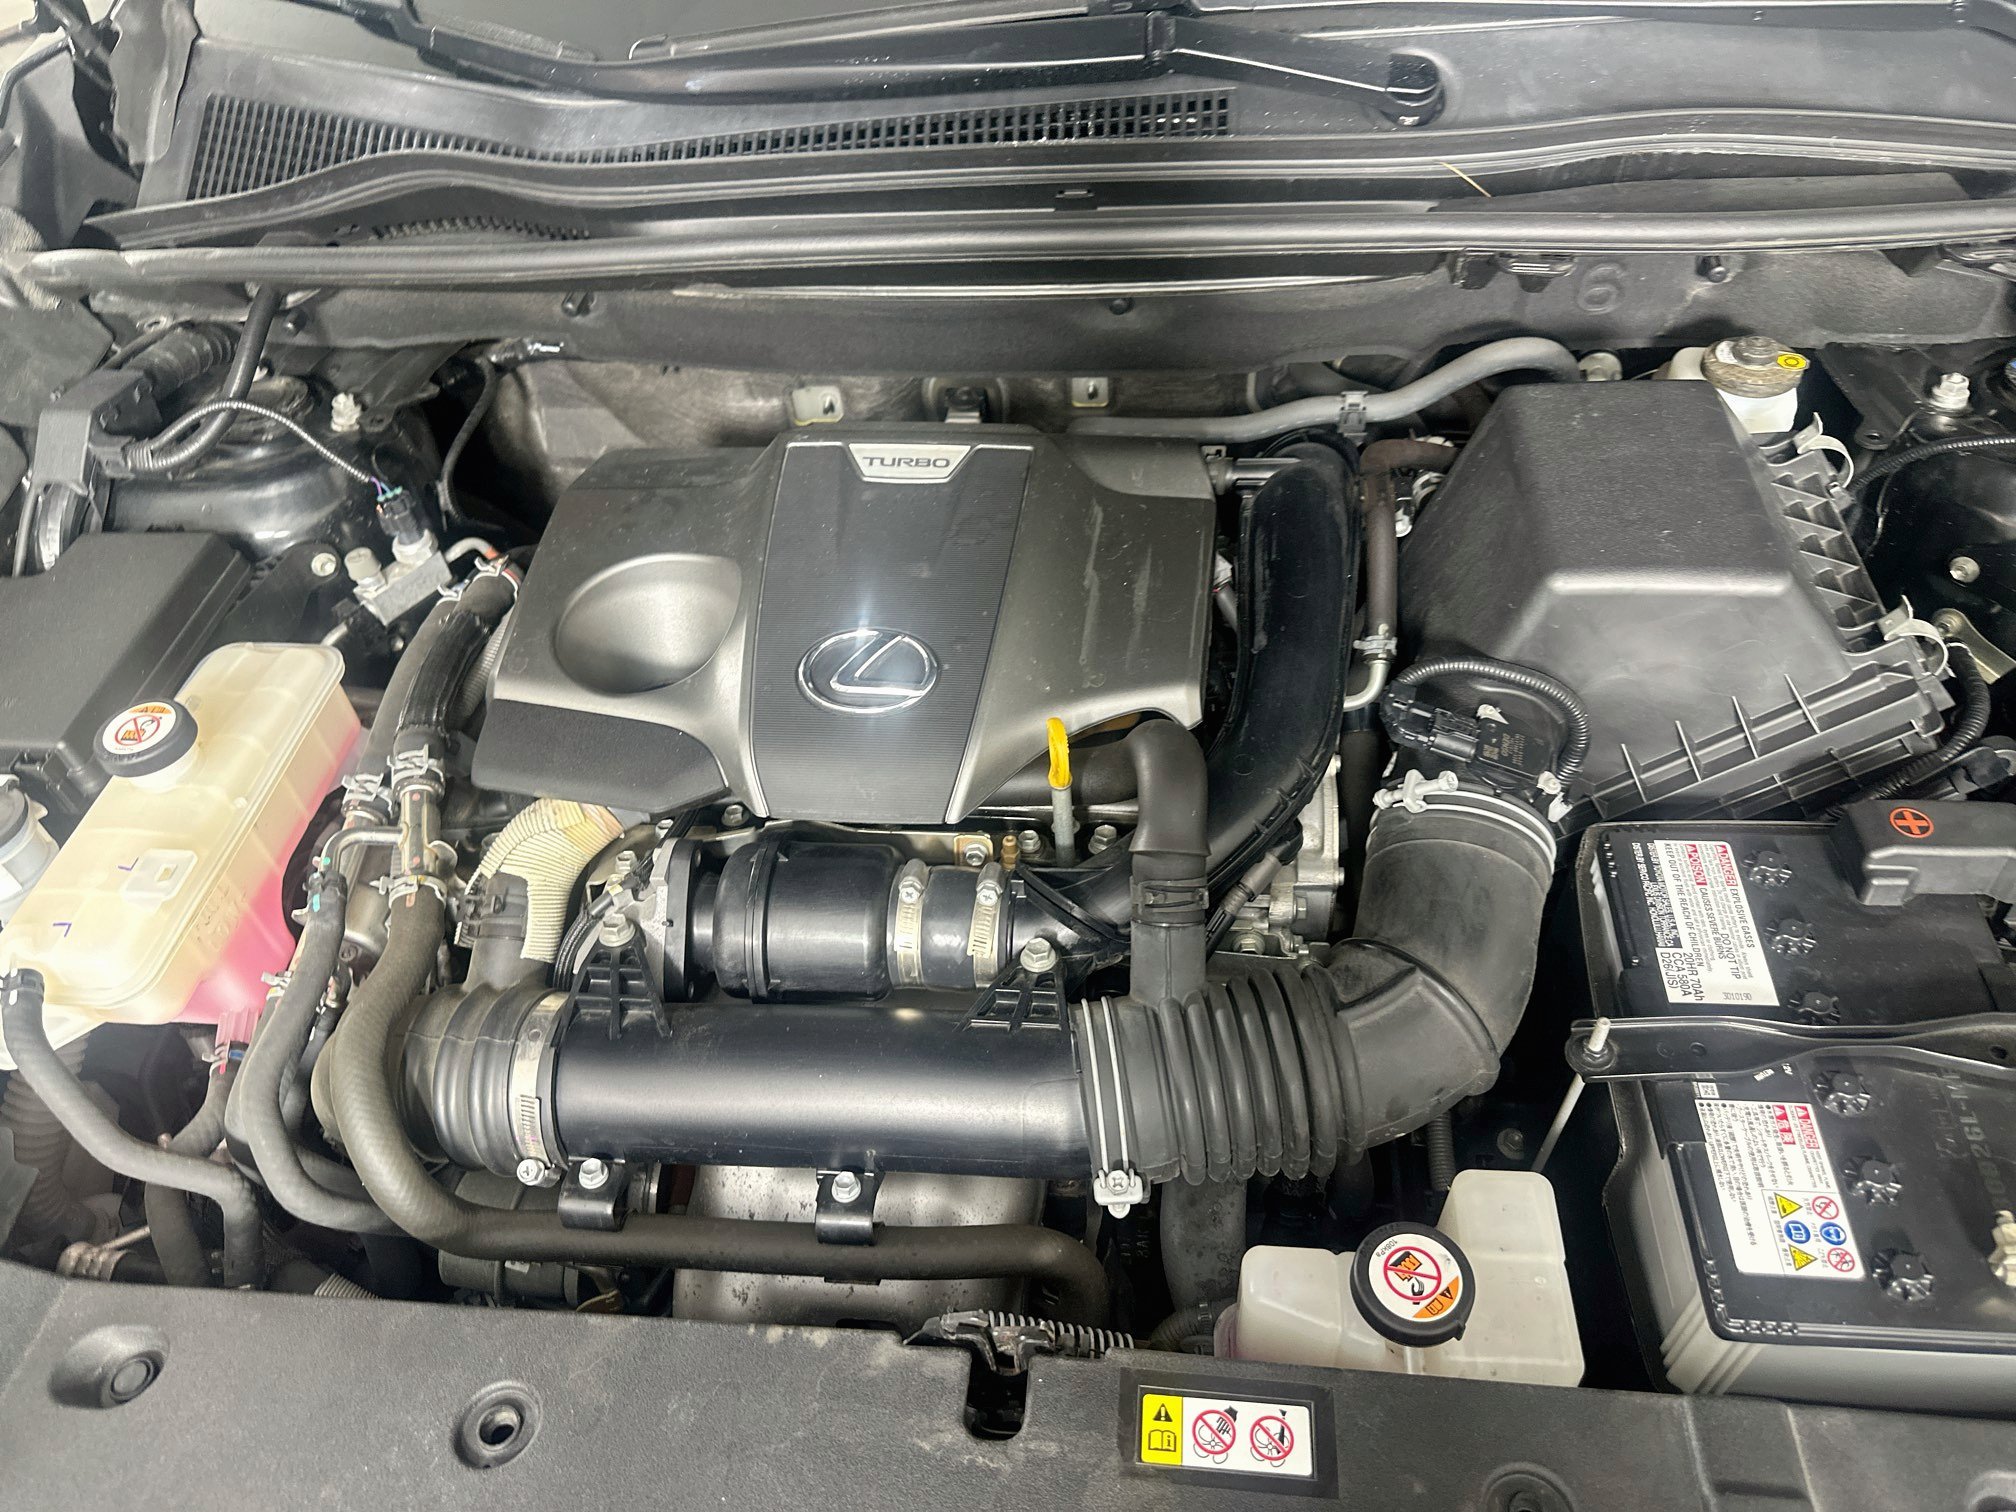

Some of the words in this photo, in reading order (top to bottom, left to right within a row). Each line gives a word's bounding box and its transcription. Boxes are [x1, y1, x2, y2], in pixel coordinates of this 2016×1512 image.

[862, 456, 950, 469] TURBO
[1664, 844, 1675, 859] KEEP
[1669, 860, 1679, 872] OUT
[1675, 885, 1686, 896] THE
[1679, 898, 1692, 920] REACH
[1688, 853, 1706, 882] POISON
[1699, 888, 1713, 911] CAUSES
[1706, 913, 1720, 935] SEVERE
[1713, 937, 1727, 959] BURNS
[1718, 853, 1737, 885] DANGER
[1730, 889, 1748, 924] EXPLOSIVE
[1741, 926, 1755, 948] GASES
[1685, 922, 1695, 930] OF
[1688, 932, 1705, 966] CHILDREN
[1720, 934, 1732, 945] DO
[1671, 953, 1686, 972] CCA
[1683, 953, 1699, 976] 20HR
[1724, 948, 1737, 964] NOT
[1660, 953, 1680, 989] D26(JIS)
[1730, 967, 1741, 979] TIP
[1677, 975, 1693, 996] 580A
[1690, 979, 1706, 1001] 70Ah
[1722, 992, 1752, 1001] 3010190
[1777, 1120, 1794, 1142] 危険
[1799, 1119, 1820, 1149] DANGER
[1375, 1239, 1398, 1257] 108kPa
